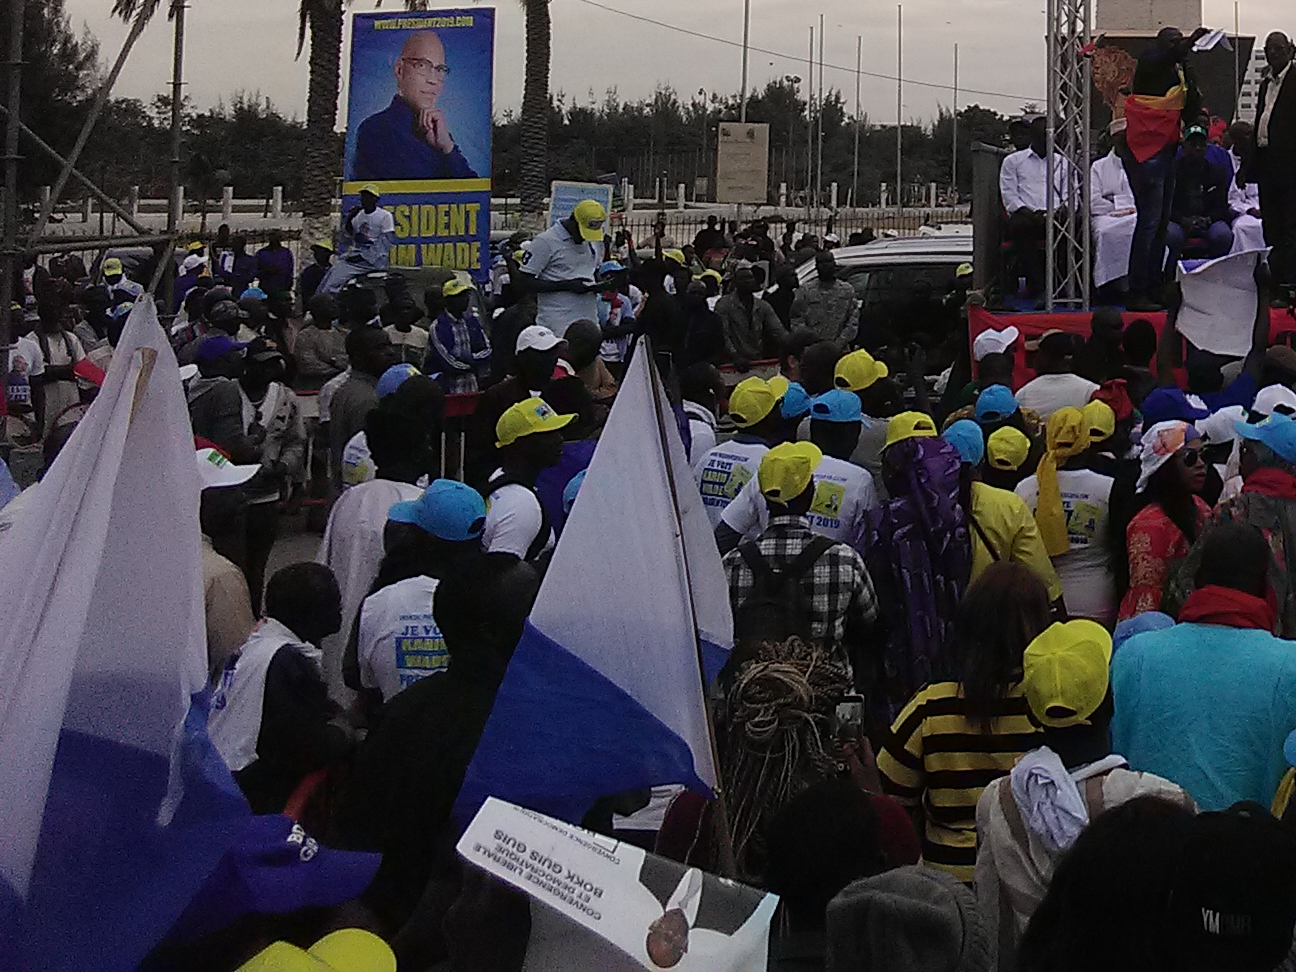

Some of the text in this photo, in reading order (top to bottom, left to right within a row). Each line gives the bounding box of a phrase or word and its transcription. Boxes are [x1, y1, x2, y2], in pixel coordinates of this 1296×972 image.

[383, 202, 481, 239] SIDENT
[421, 241, 481, 269] WADE
[816, 516, 840, 529] 2019
[401, 625, 419, 636] JE
[473, 842, 602, 921] CONVERGENCE LIBERALE
[493, 829, 606, 899] BOKK GUIS GUIS
[494, 843, 592, 904] ET DEMOCRATIQUE
